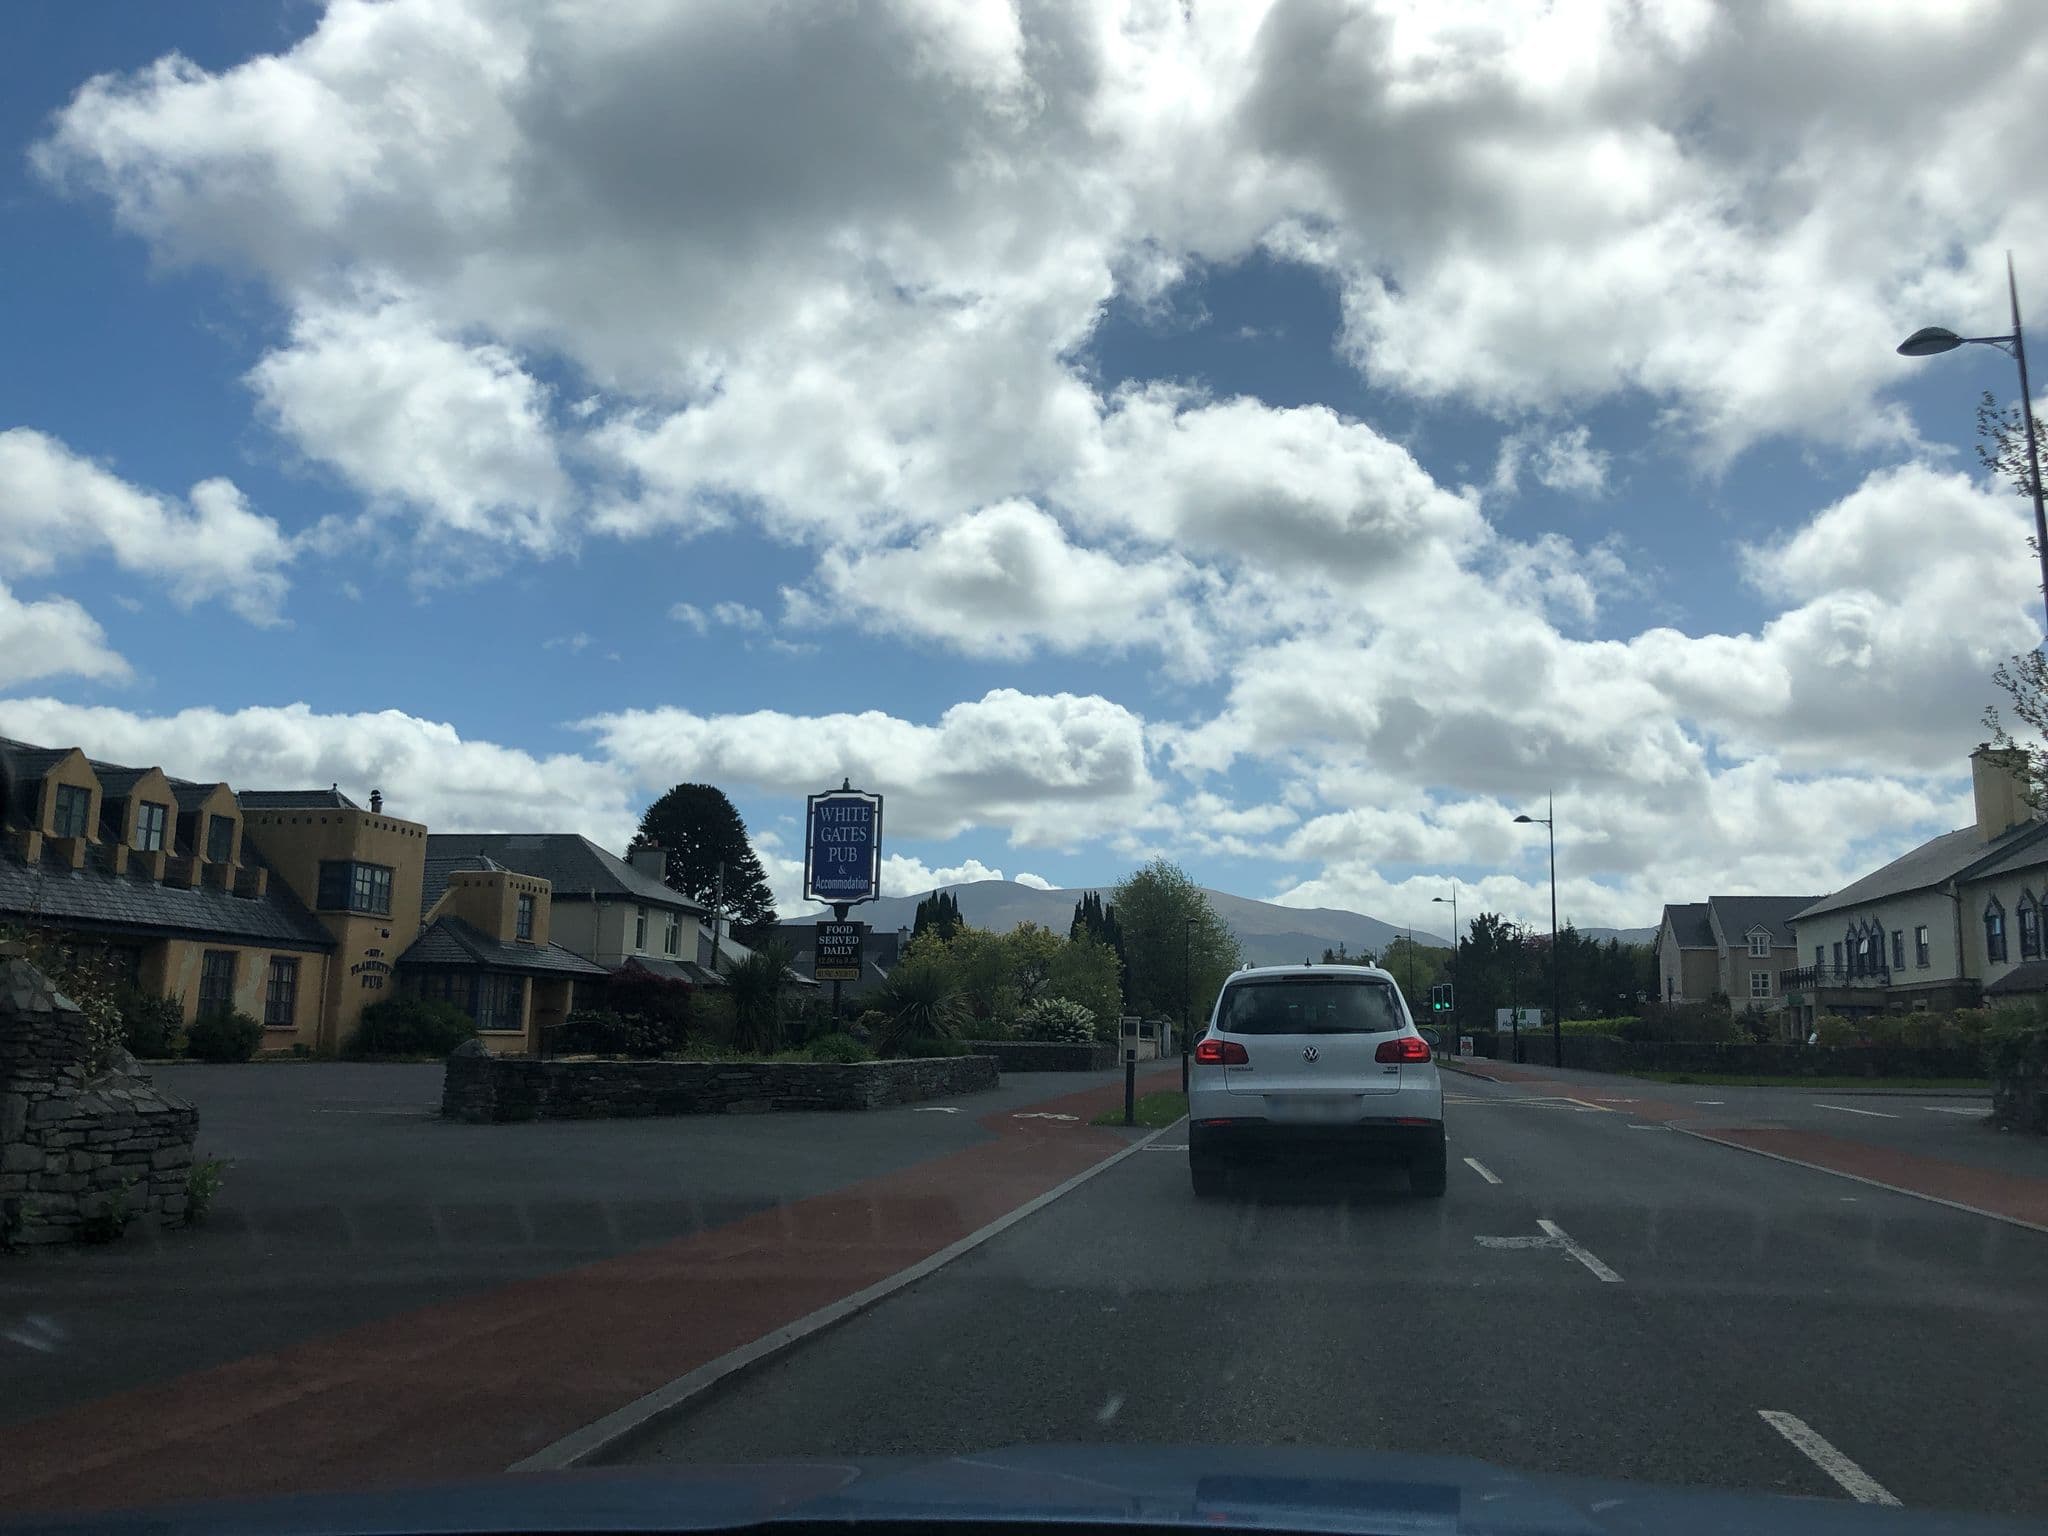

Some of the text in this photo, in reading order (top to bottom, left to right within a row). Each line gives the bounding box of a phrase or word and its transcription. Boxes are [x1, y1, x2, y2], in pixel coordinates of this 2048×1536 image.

[820, 807, 870, 822] WHITE
[821, 826, 867, 842] GATES
[828, 847, 857, 863] PUB
[838, 865, 848, 875] &
[815, 875, 869, 889] Accommodation
[826, 925, 854, 935] FOOD
[818, 935, 859, 945] SERVED
[824, 946, 854, 955] DAILY
[362, 975, 382, 988] PUB
